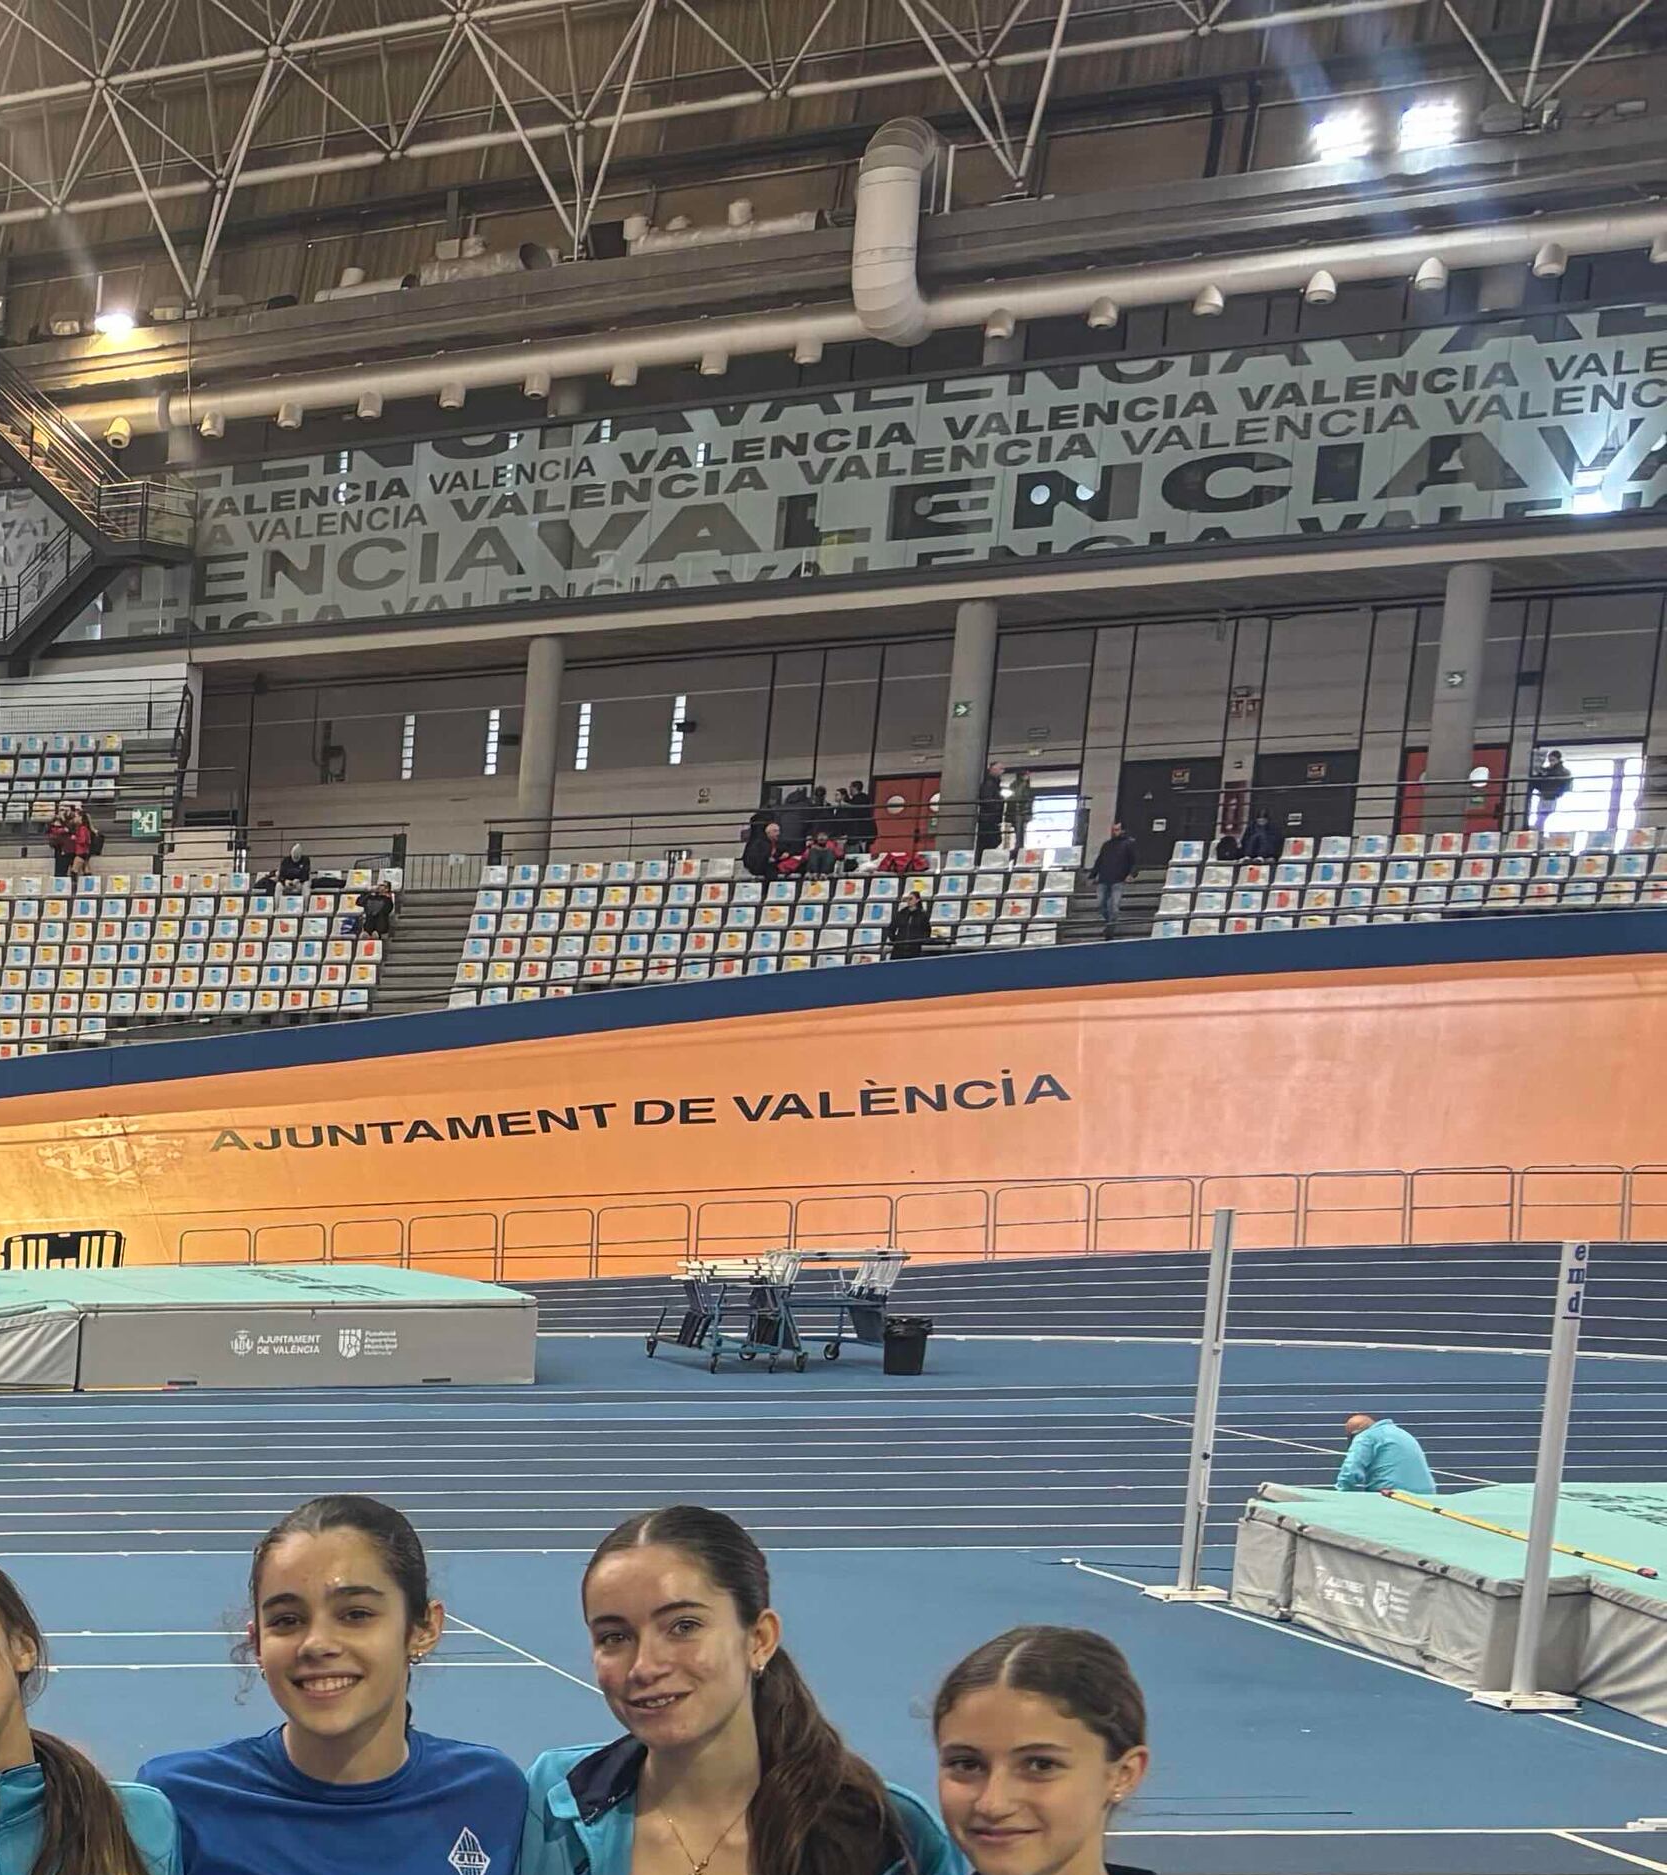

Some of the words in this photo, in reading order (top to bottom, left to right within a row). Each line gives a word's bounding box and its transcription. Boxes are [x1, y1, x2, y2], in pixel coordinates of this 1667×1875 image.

[429, 456, 596, 494] VALENCIA
[620, 422, 916, 474] VALENCIA
[944, 391, 1218, 440] VALENCIA
[1238, 361, 1519, 411] VALENCIA
[248, 503, 428, 543] VALENCIA
[449, 466, 769, 522] VALENCIA
[798, 432, 1097, 485] VALENCIA
[1120, 404, 1419, 456] VALENCIA
[209, 1102, 617, 1153] AJUNTAMENT
[633, 1096, 717, 1126] DE
[257, 1334, 322, 1344] AJUNTAMENT
[257, 1346, 270, 1355] DE
